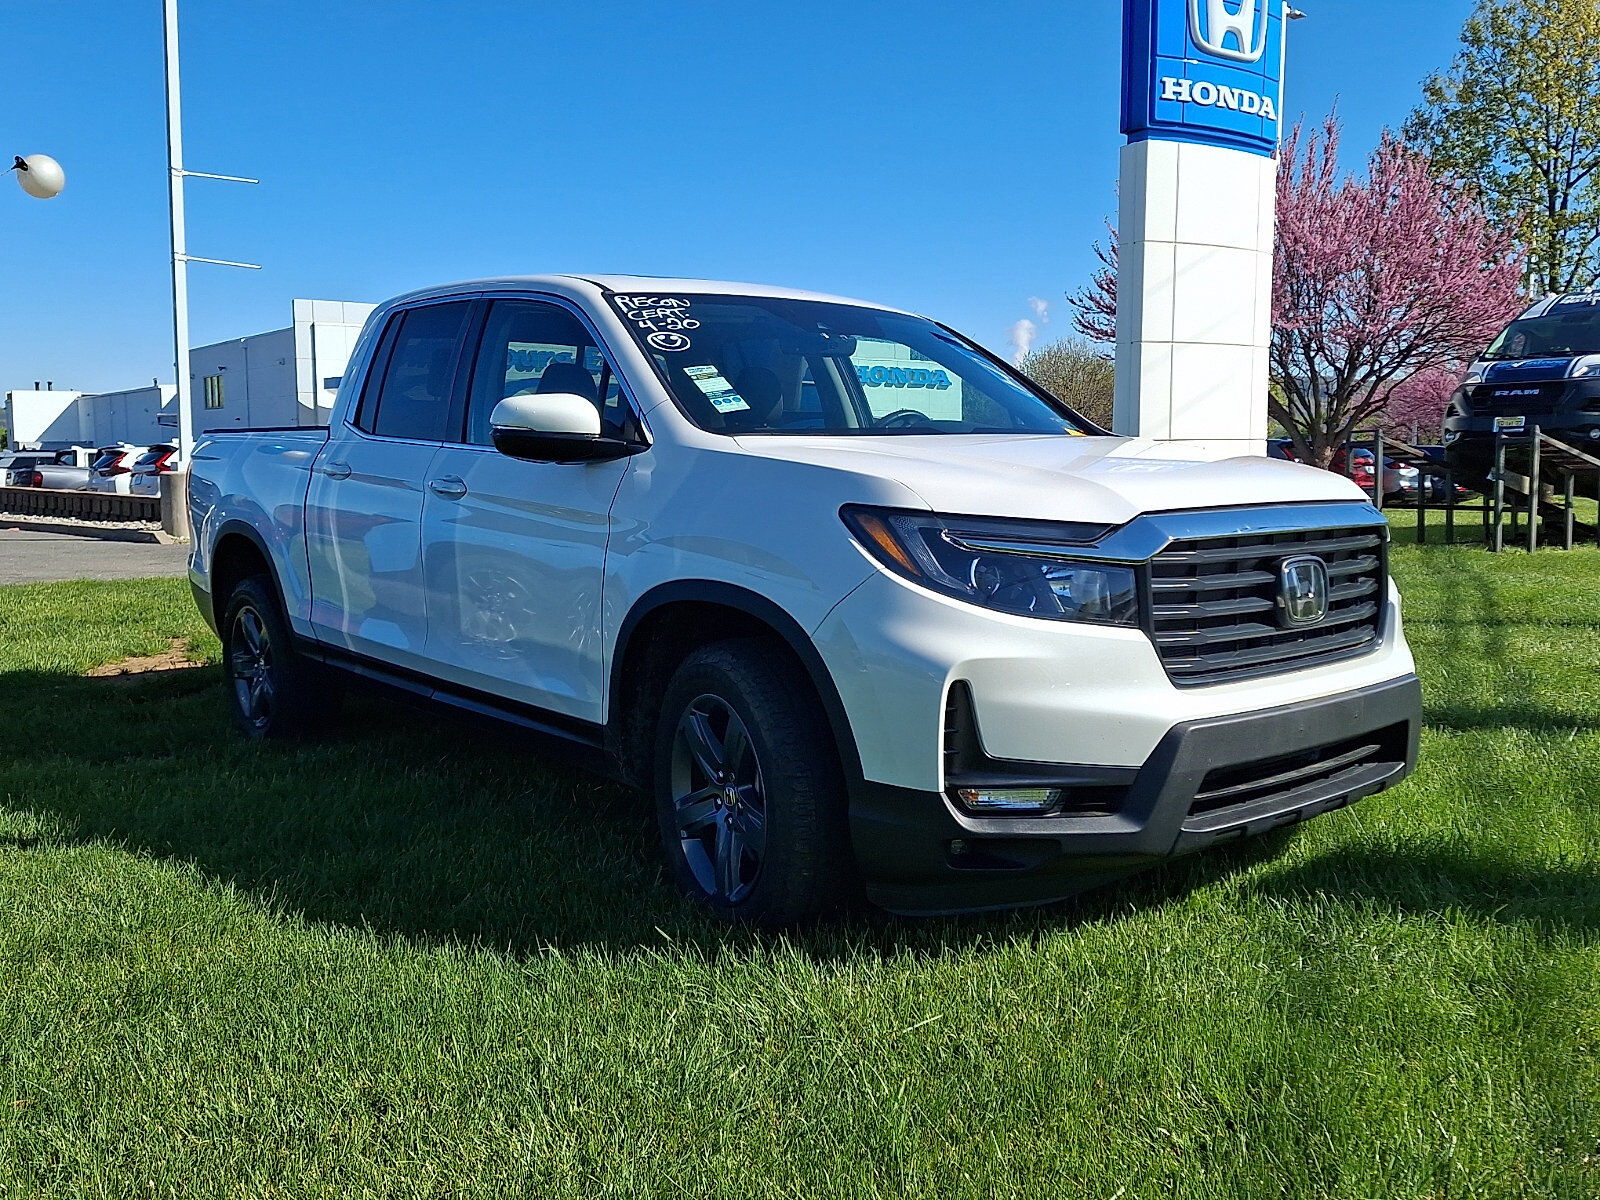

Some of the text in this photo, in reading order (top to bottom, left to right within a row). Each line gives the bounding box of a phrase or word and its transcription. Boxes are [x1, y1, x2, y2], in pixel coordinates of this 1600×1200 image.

[1161, 77, 1277, 120] HONDA
[614, 295, 690, 313] RECON
[639, 318, 700, 331] 4-20
[1495, 389, 1539, 397] RAM
